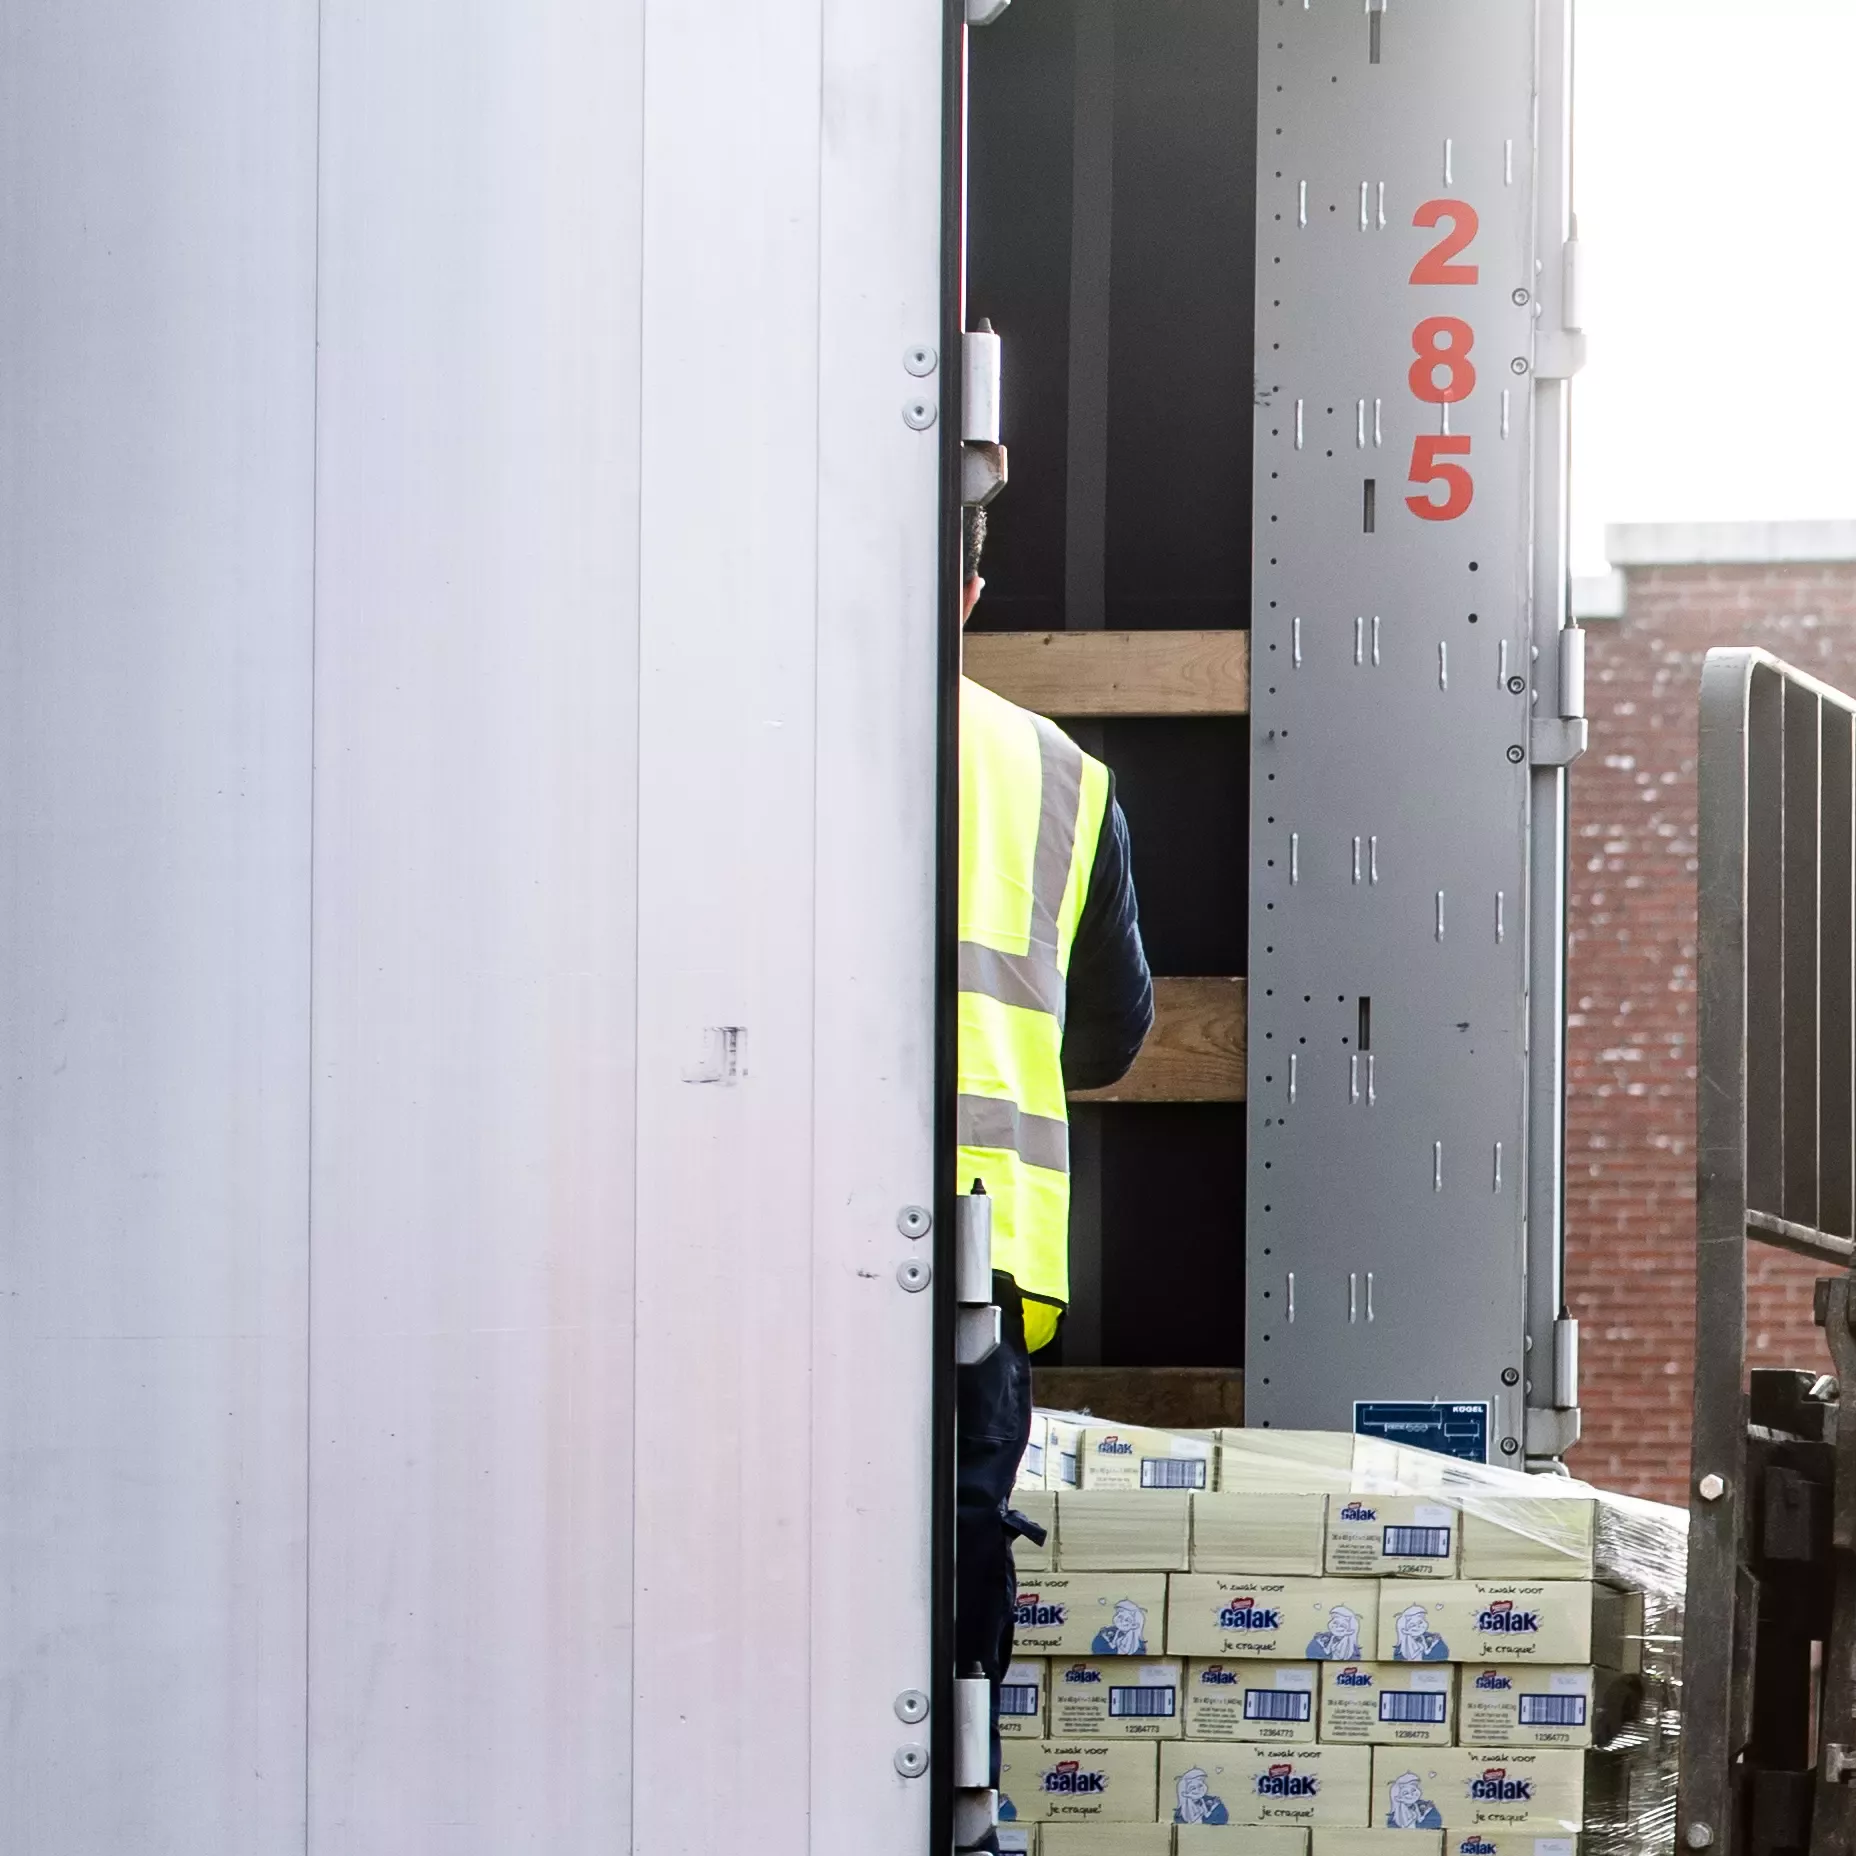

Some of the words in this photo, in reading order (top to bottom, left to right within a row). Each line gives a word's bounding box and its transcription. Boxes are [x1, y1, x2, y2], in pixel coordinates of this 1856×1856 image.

[1405, 198, 1479, 522] 285
[1341, 1508, 1376, 1521] Galak
[1044, 1580, 1069, 1588] voor
[1260, 1584, 1285, 1592] voor
[1220, 1609, 1279, 1629] Galak
[1479, 1611, 1538, 1632] Galak
[1220, 1638, 1233, 1653] je
[1479, 1642, 1492, 1656] je
[1065, 1671, 1102, 1683] Galak
[1202, 1671, 1238, 1684] Galak
[1336, 1674, 1373, 1687] Galak
[1476, 1677, 1512, 1690] Galak
[1512, 1755, 1536, 1763] voor
[1045, 1773, 1104, 1792] Galak
[1258, 1775, 1317, 1796] Galak
[1471, 1780, 1531, 1800] Galak
[1046, 1803, 1060, 1817] je
[1258, 1805, 1272, 1820] je
[1472, 1812, 1485, 1825] je
[1460, 1842, 1497, 1855] Galak
